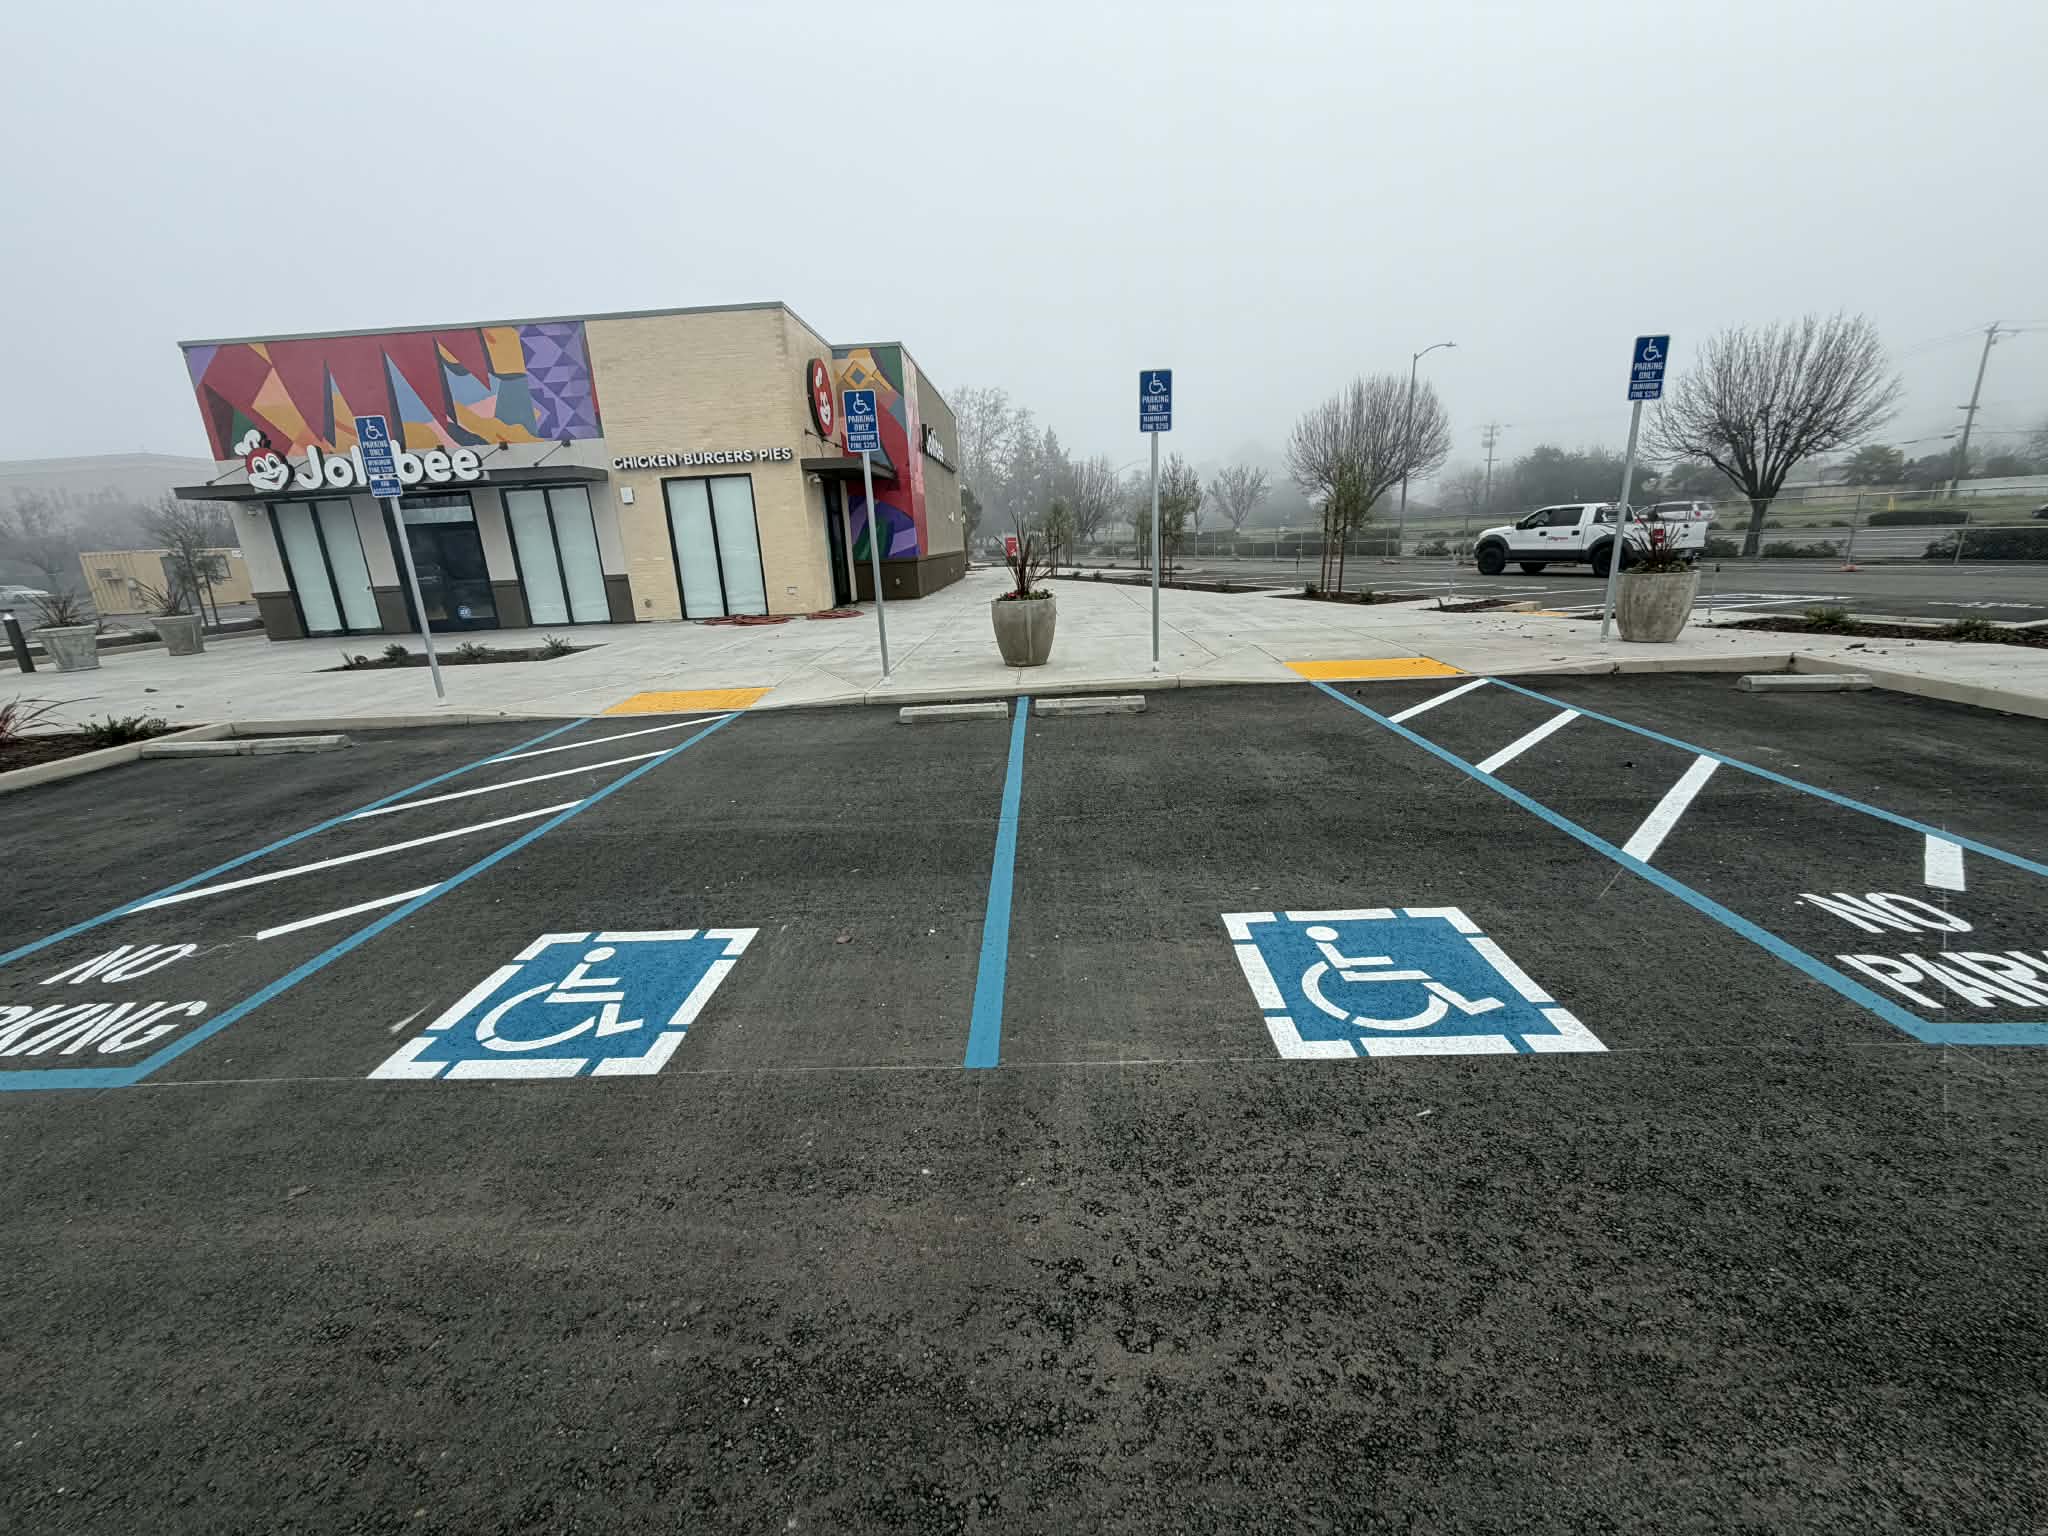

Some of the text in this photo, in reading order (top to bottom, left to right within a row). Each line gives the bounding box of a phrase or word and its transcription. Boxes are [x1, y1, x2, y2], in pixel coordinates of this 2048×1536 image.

[1634, 361, 1664, 371] PARKING
[1638, 371, 1656, 379] ONLY
[1632, 382, 1659, 390] MINIMUM
[1142, 395, 1169, 404] PARKING
[1630, 391, 1643, 399] FINE
[1147, 404, 1163, 412] ONLY
[847, 415, 875, 424] PARKING
[854, 423, 869, 431] ONLY
[362, 440, 389, 449] PARKING
[369, 448, 385, 456] ONLY
[612, 447, 793, 471] CHICKEN BURGERS PIES
[295, 440, 481, 489] Jolbee
[1794, 892, 1973, 933] NO
[38, 943, 198, 984] NO
